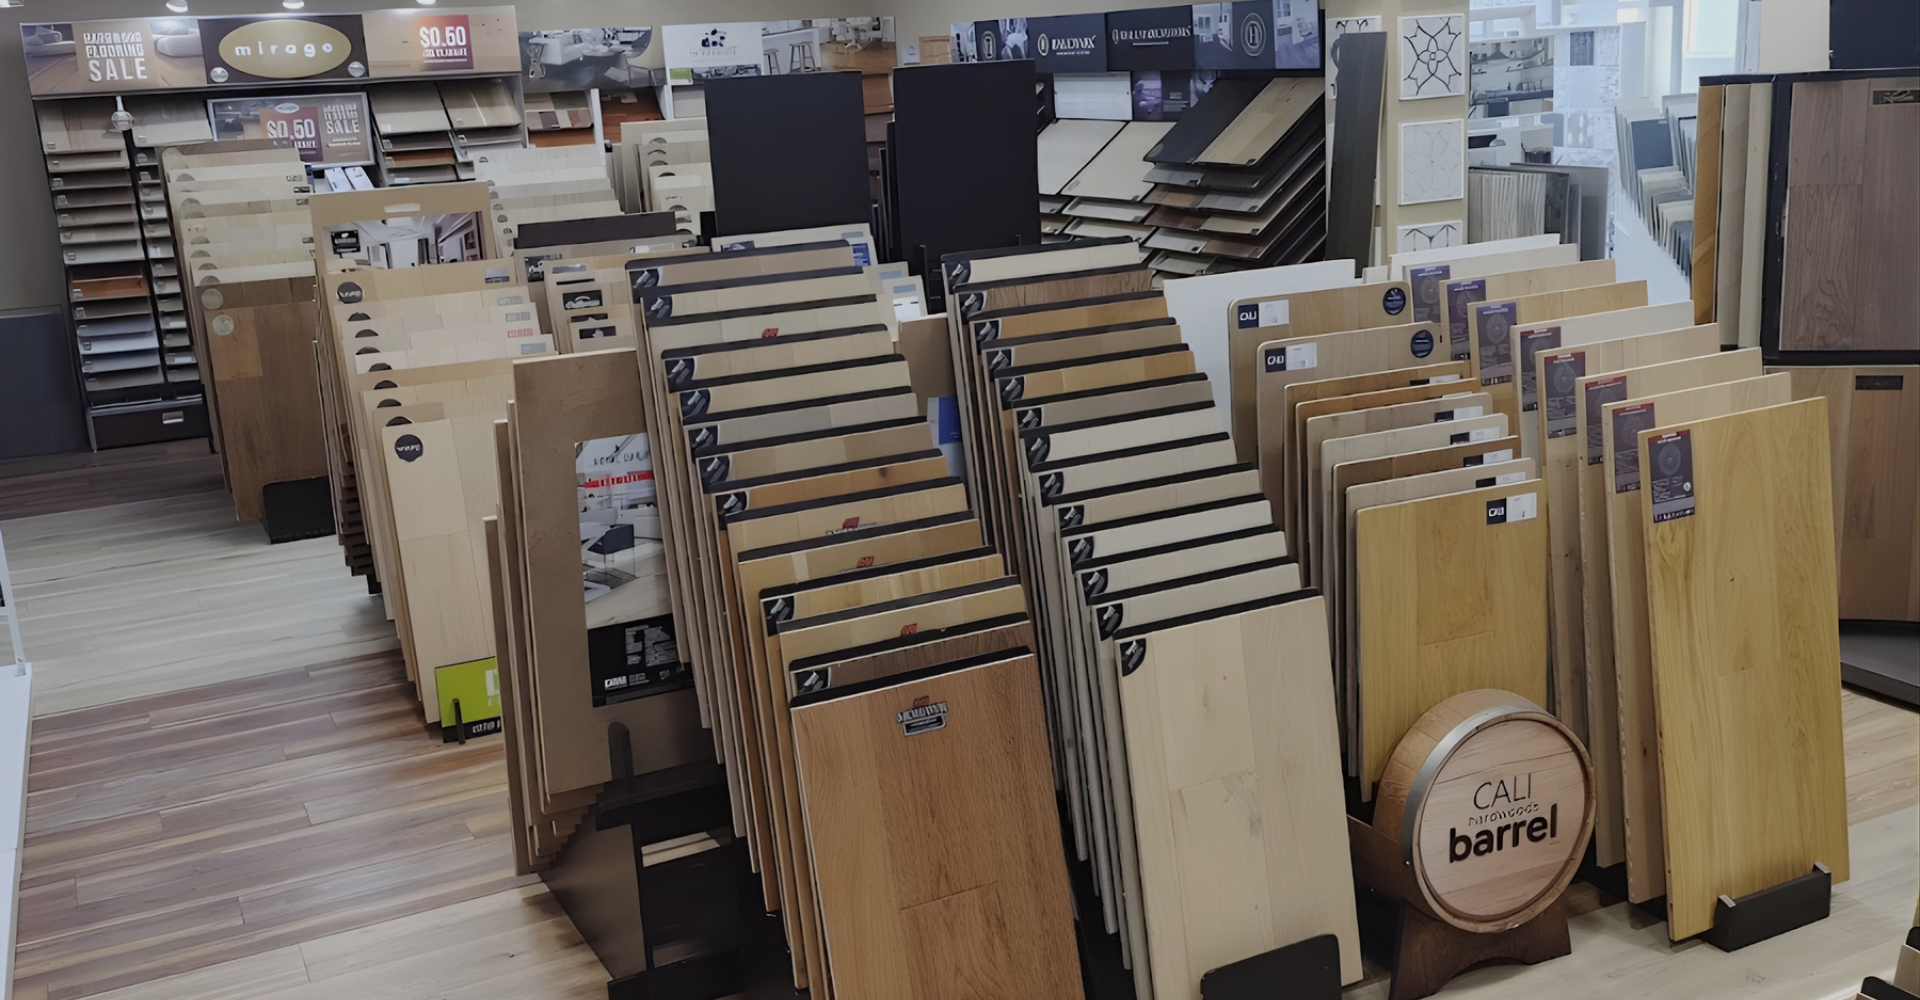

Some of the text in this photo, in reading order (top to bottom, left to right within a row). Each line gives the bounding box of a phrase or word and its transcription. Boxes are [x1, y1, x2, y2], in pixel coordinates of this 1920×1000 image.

[418, 25, 467, 48] $0.50
[88, 57, 148, 82] SALE
[266, 118, 317, 139] $0.50
[325, 119, 360, 134] SALE
[1473, 772, 1532, 810] CALI
[1449, 802, 1558, 864] barrel
